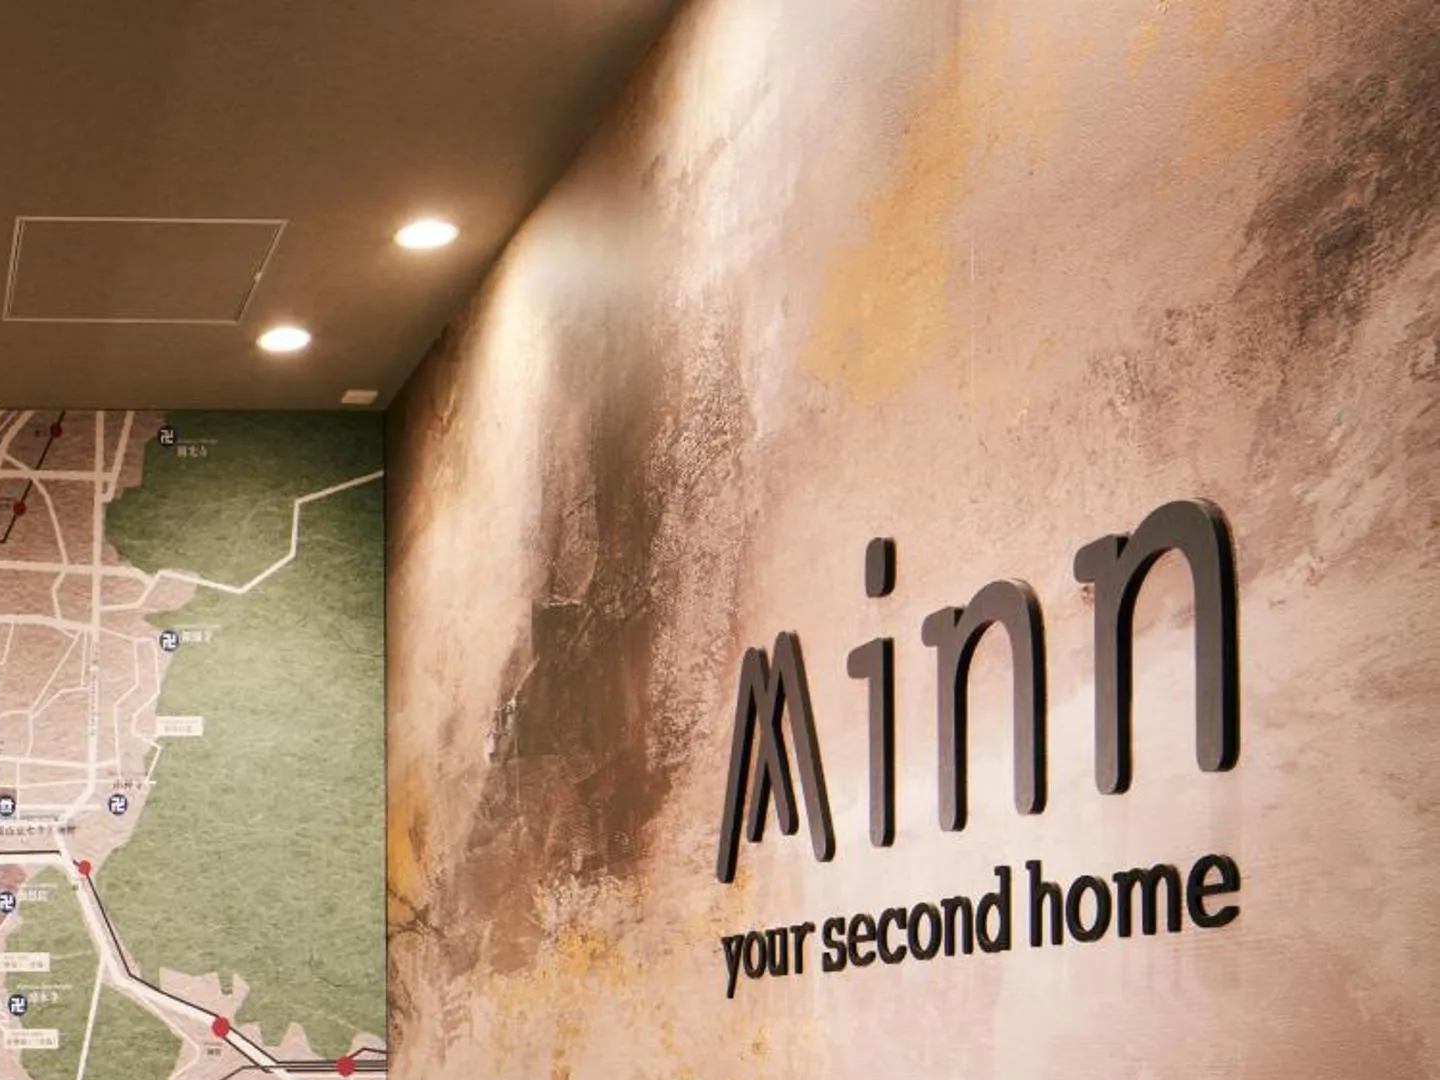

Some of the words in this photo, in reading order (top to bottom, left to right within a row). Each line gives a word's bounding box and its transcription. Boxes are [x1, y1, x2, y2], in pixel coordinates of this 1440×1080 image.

[716, 498, 1241, 884] Minn
[722, 920, 815, 999] your
[821, 865, 1012, 973] second
[1026, 854, 1241, 947] home
